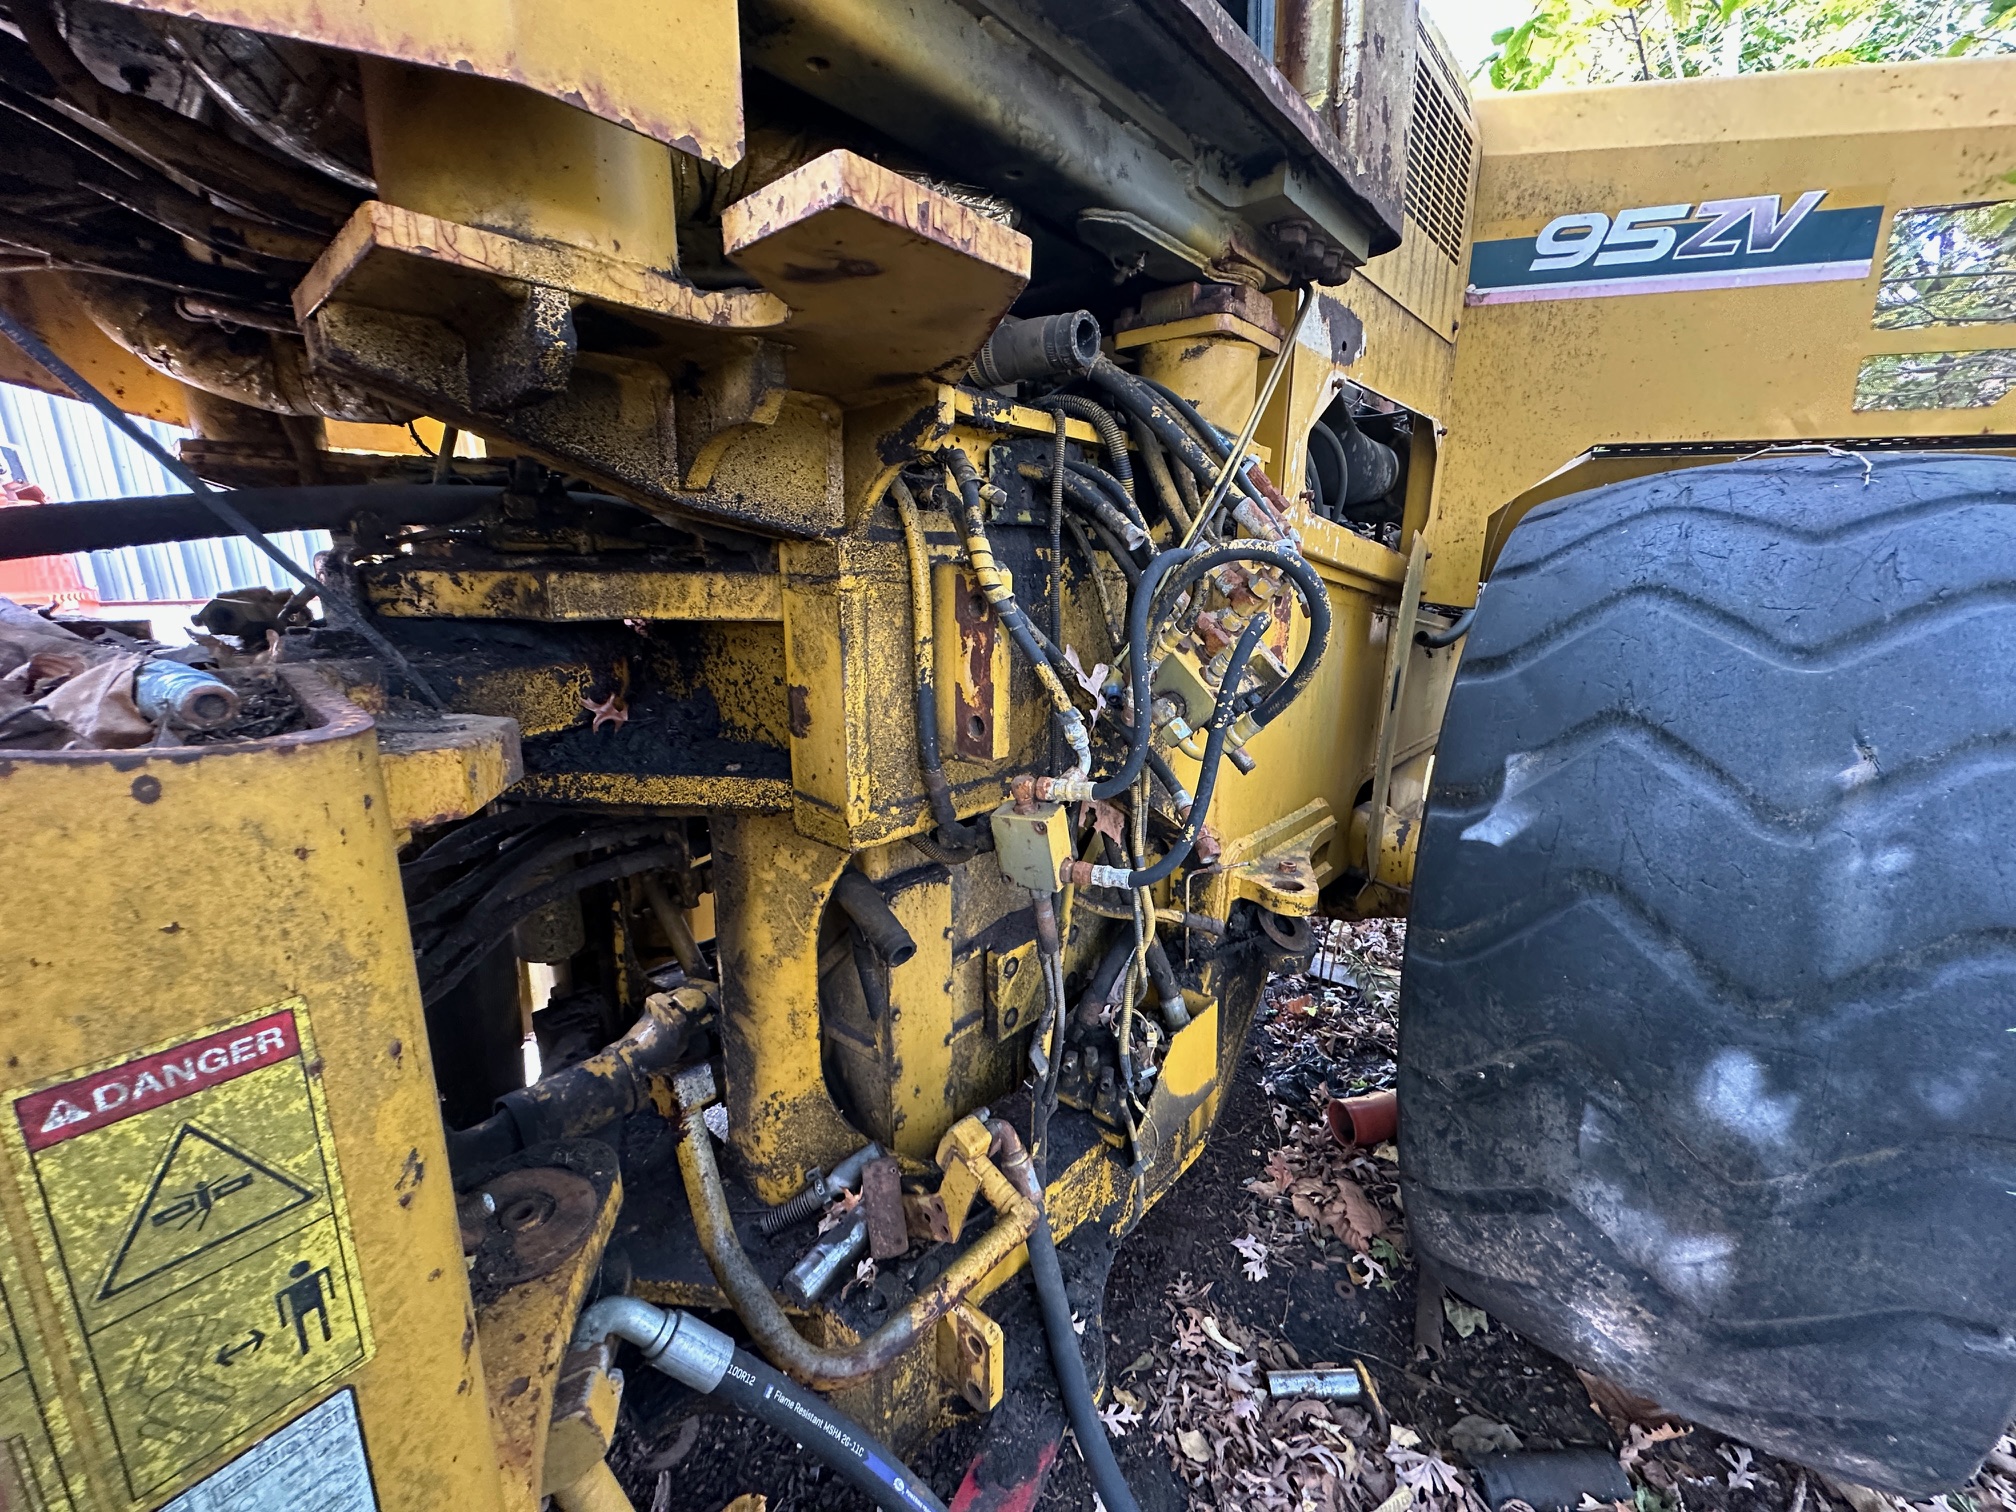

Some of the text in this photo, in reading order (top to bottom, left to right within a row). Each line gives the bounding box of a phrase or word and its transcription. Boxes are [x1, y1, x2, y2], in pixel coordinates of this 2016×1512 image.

[1529, 189, 1827, 271] 95ZV
[92, 1026, 286, 1113] DANGER
[727, 1364, 756, 1386] 100R12
[773, 1390, 795, 1410] Flame
[793, 1402, 824, 1429] Resistant
[822, 1421, 842, 1441] MSHA
